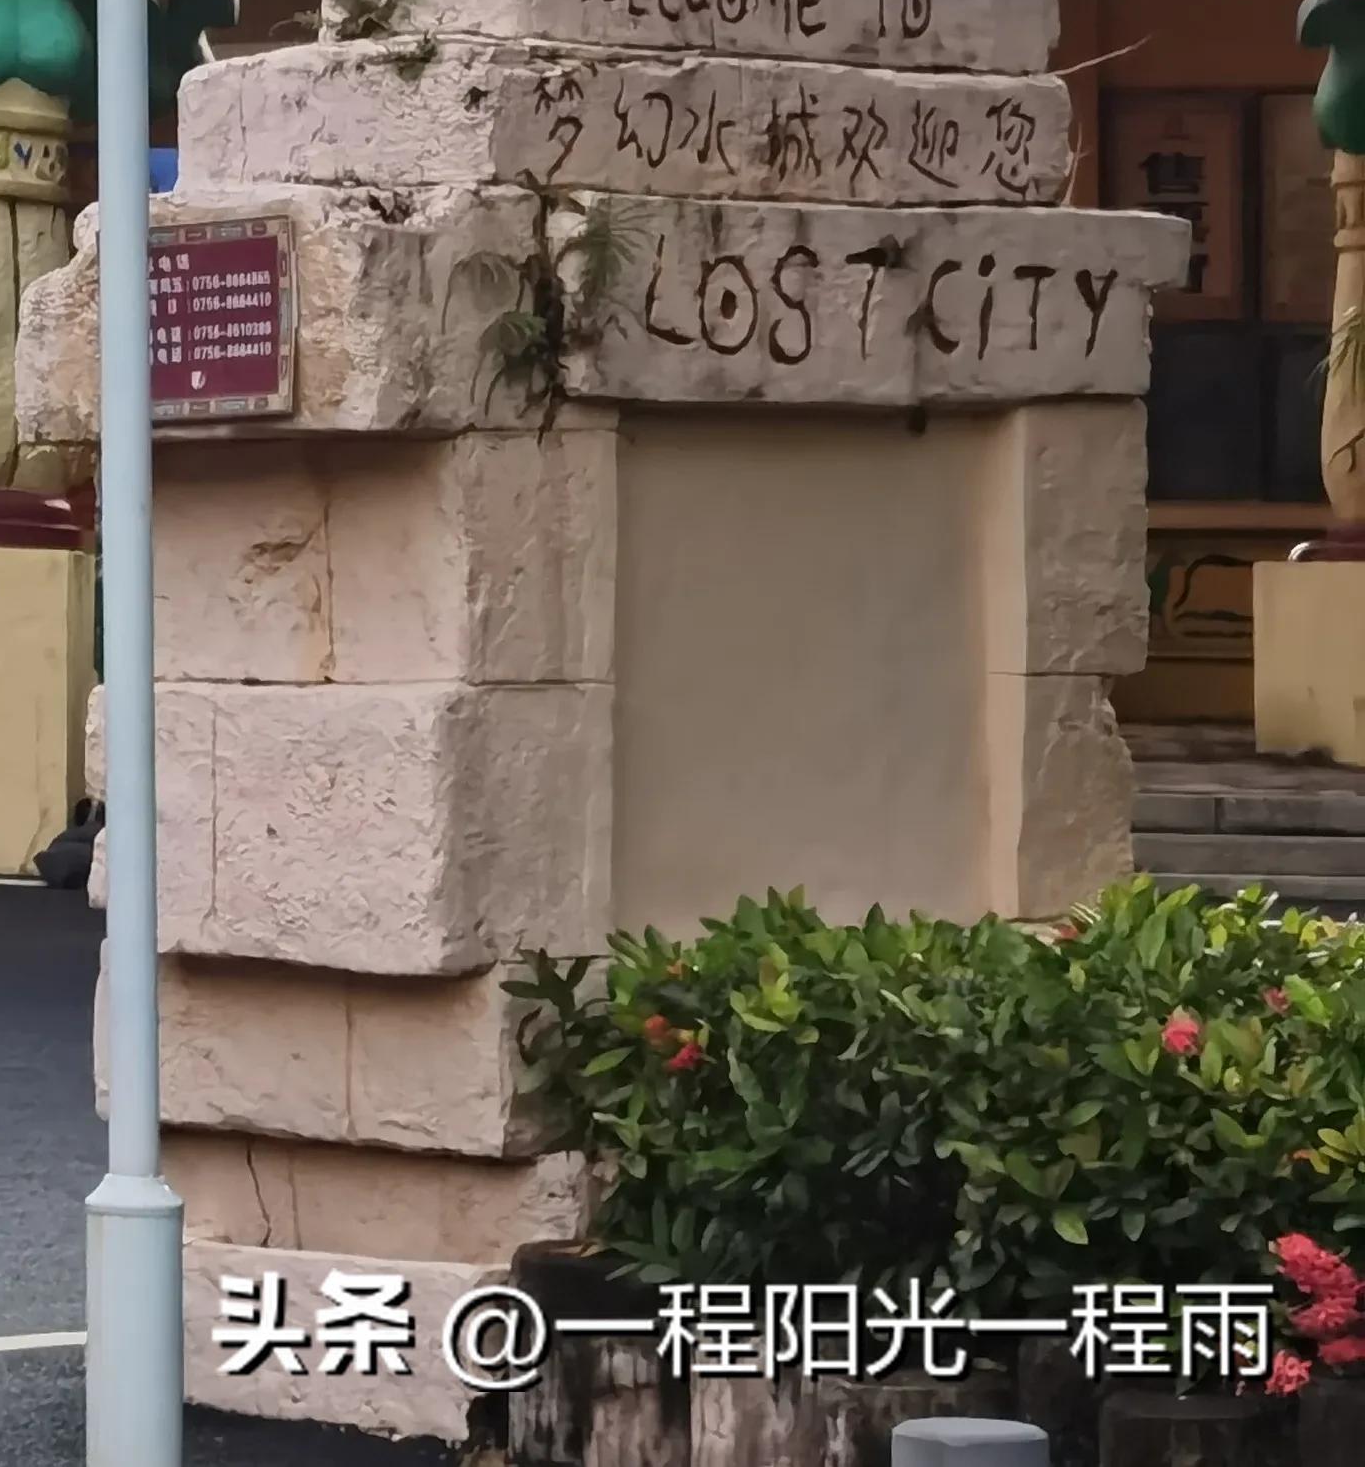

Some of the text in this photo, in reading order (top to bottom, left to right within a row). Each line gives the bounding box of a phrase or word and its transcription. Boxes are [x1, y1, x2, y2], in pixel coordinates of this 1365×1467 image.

[532, 70, 1037, 197] 梦幻水城欢迎您
[645, 232, 904, 365] LOST
